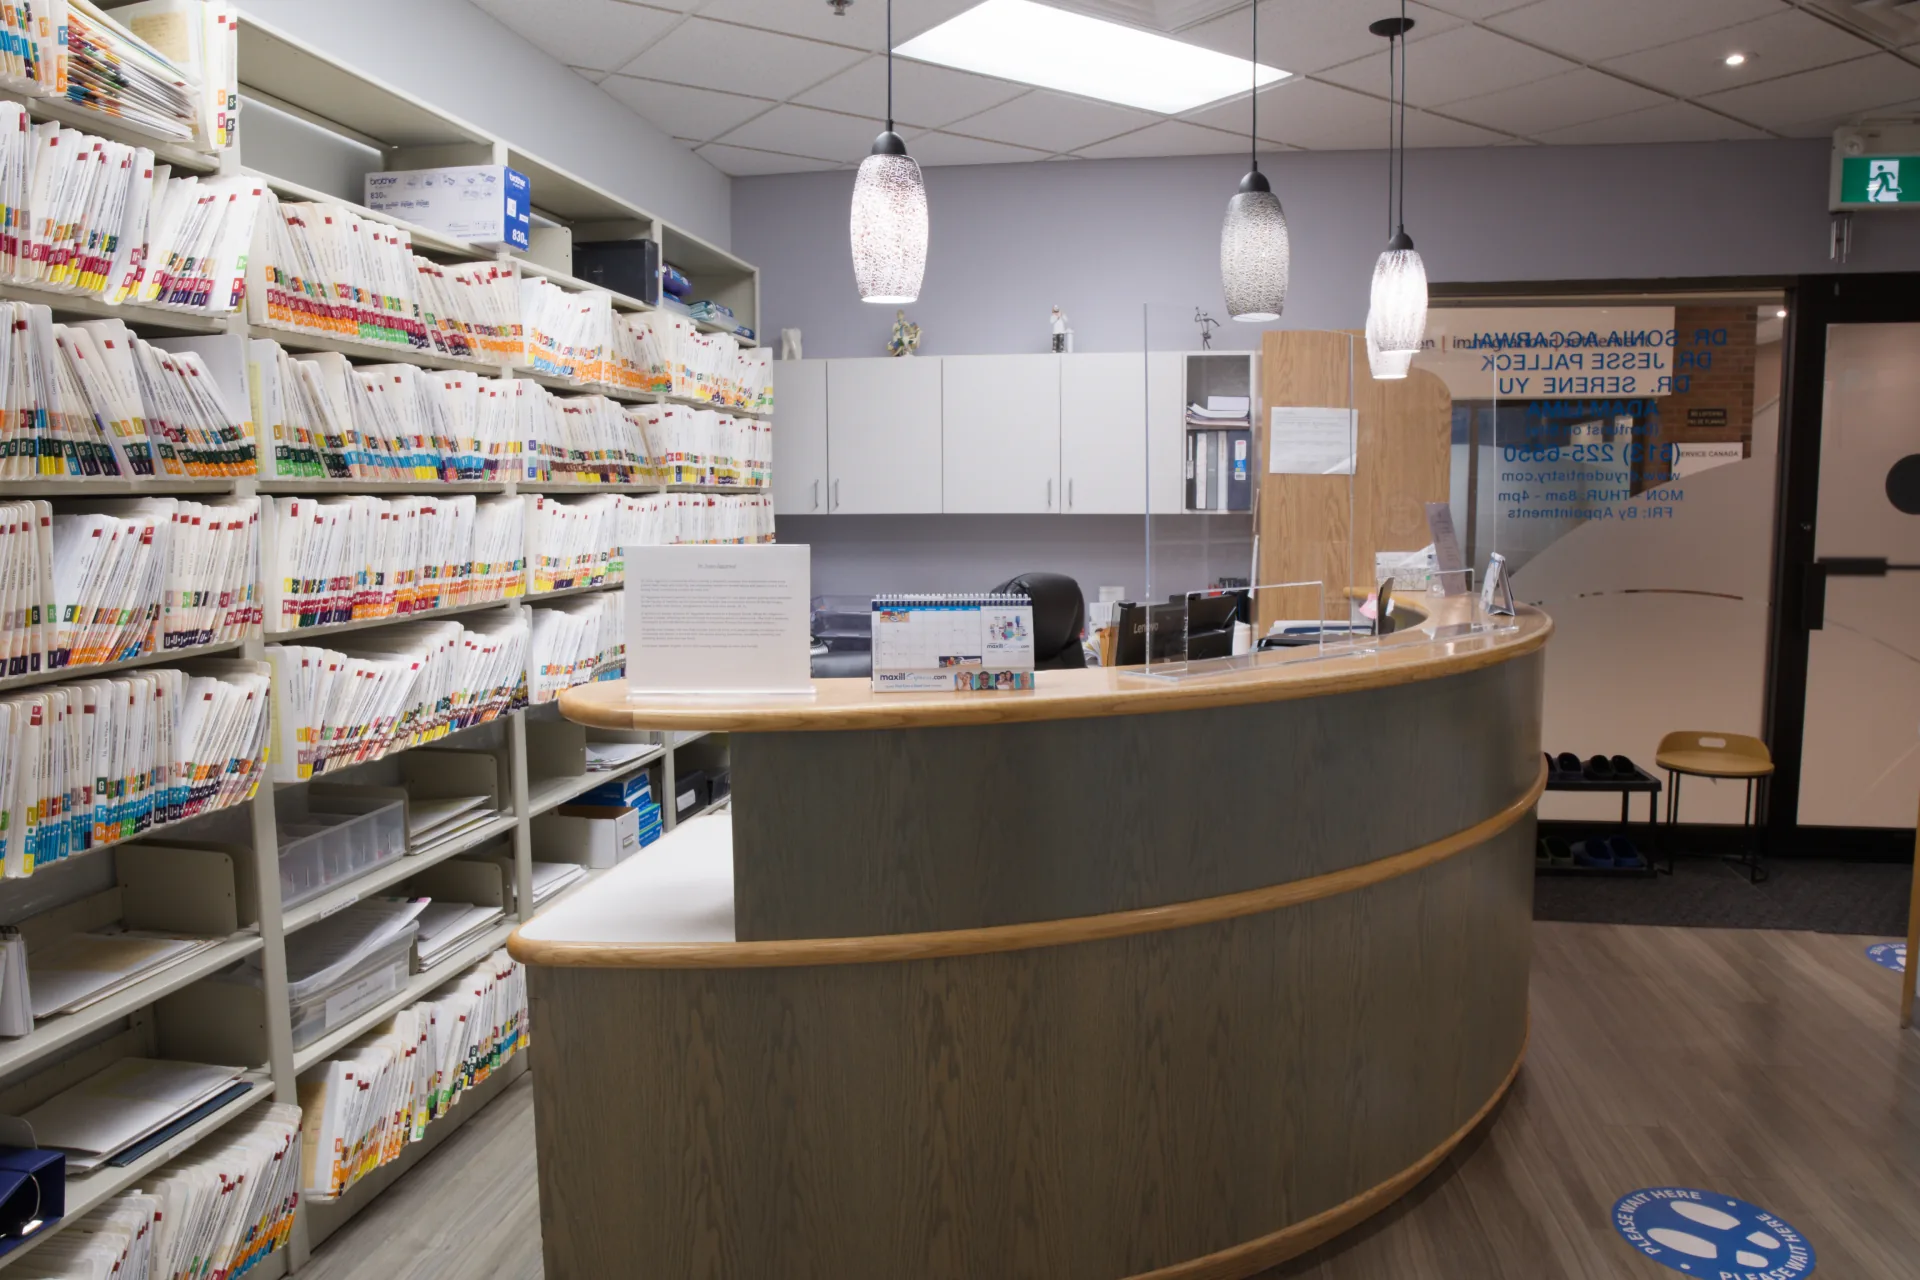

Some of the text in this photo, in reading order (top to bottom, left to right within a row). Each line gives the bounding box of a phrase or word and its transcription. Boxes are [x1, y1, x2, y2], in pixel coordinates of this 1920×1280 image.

[370, 177, 398, 186] brother
[1679, 450, 1739, 458] ERVICE CANADA
[1133, 623, 1159, 634] Lenvo
[1618, 1189, 1702, 1255] PLEASE WAIT HERE
[1755, 1212, 1801, 1243] HERE
[1785, 1245, 1808, 1272] WAIT
